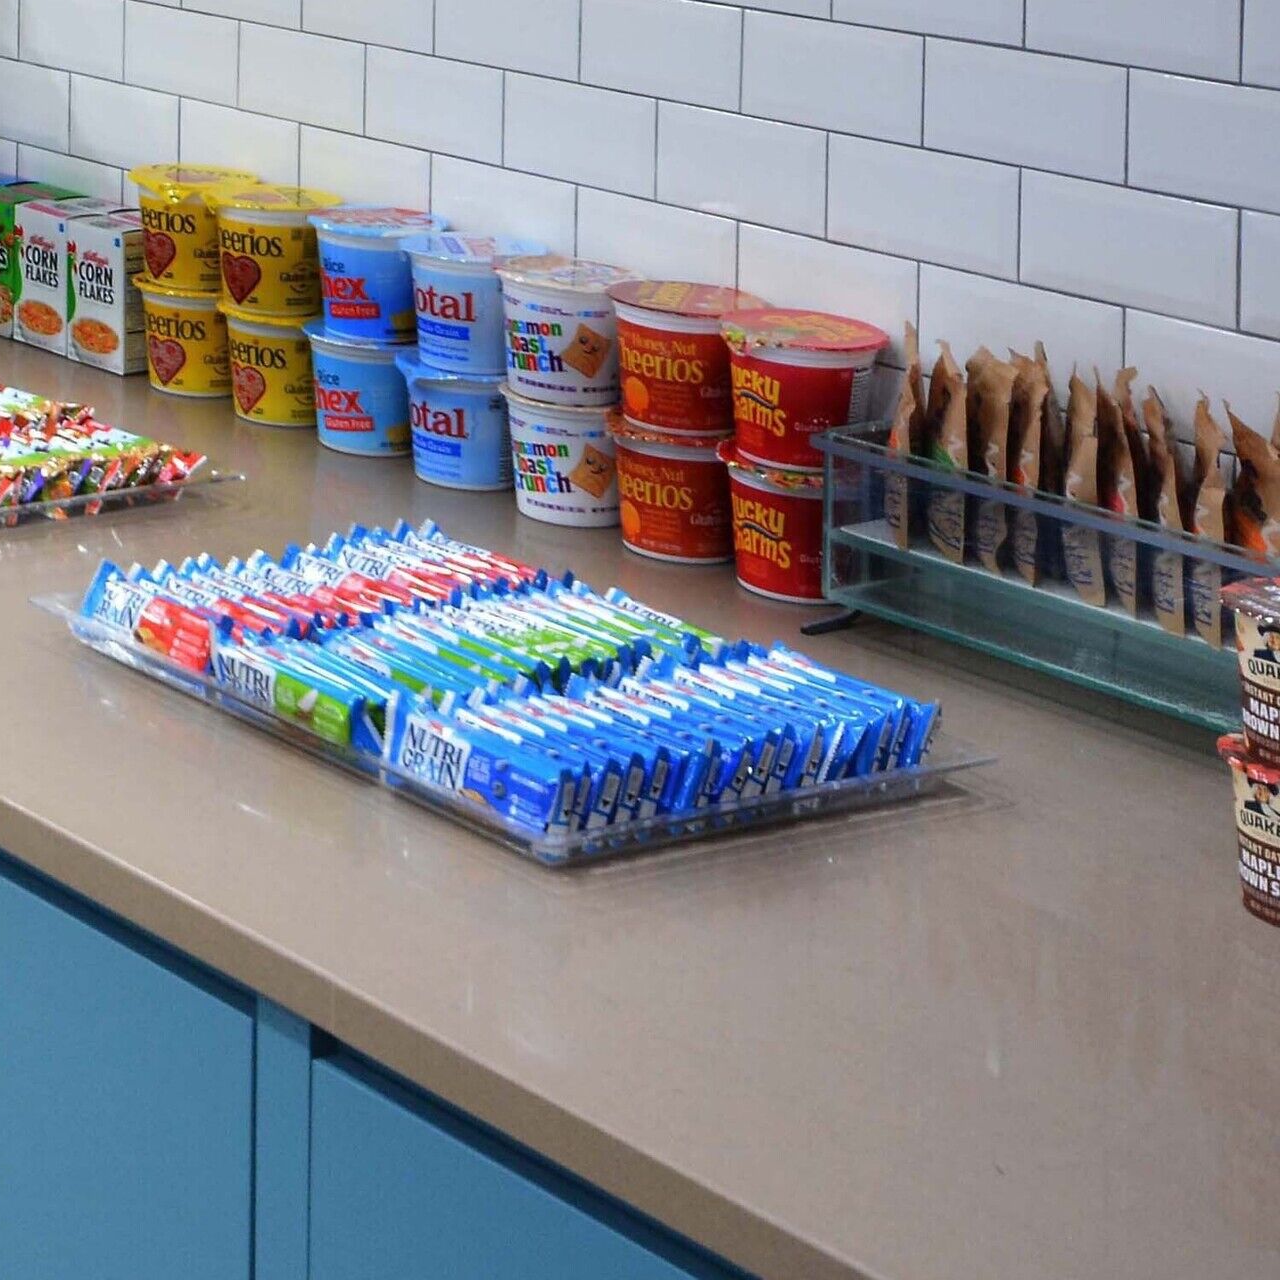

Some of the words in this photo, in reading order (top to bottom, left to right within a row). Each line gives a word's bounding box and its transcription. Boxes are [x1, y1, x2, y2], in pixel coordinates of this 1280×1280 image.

[25, 245, 58, 271] CORN
[25, 265, 59, 288] FLAKES
[79, 261, 113, 287] CORN
[79, 281, 114, 305] FLAKES
[413, 283, 477, 323] otal
[505, 318, 562, 336] namon
[619, 337, 705, 384] heerios
[672, 340, 697, 356] Nut
[410, 400, 469, 438] otal
[512, 440, 569, 457] namon
[660, 467, 686, 483] Nut
[217, 652, 270, 691] NUTRI
[1249, 696, 1280, 721] MAP
[405, 722, 463, 766] NUTRI
[402, 747, 460, 790] GRAIN
